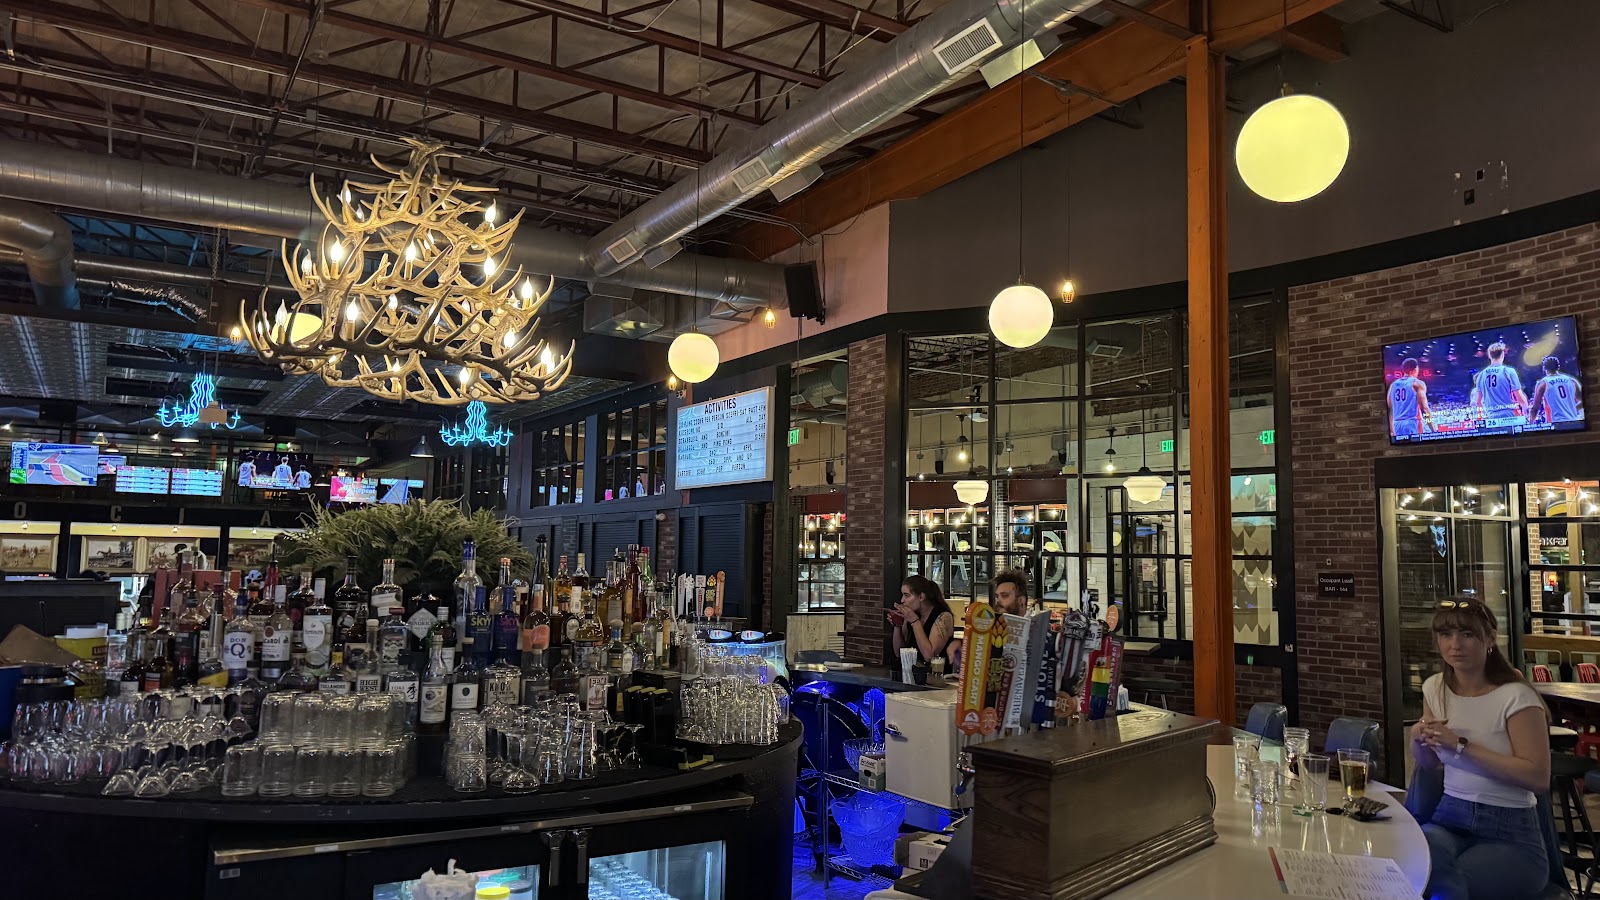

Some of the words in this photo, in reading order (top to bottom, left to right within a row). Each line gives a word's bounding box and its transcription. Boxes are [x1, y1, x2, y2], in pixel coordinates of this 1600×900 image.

[1486, 374, 1497, 388] 13
[1395, 388, 1407, 402] 30
[1558, 385, 1567, 399] 0
[705, 398, 736, 414] ACTIVITIES
[471, 616, 492, 626] SKYY
[230, 642, 246, 659] Q
[973, 636, 985, 676] MANGO
[970, 677, 981, 706] CART
